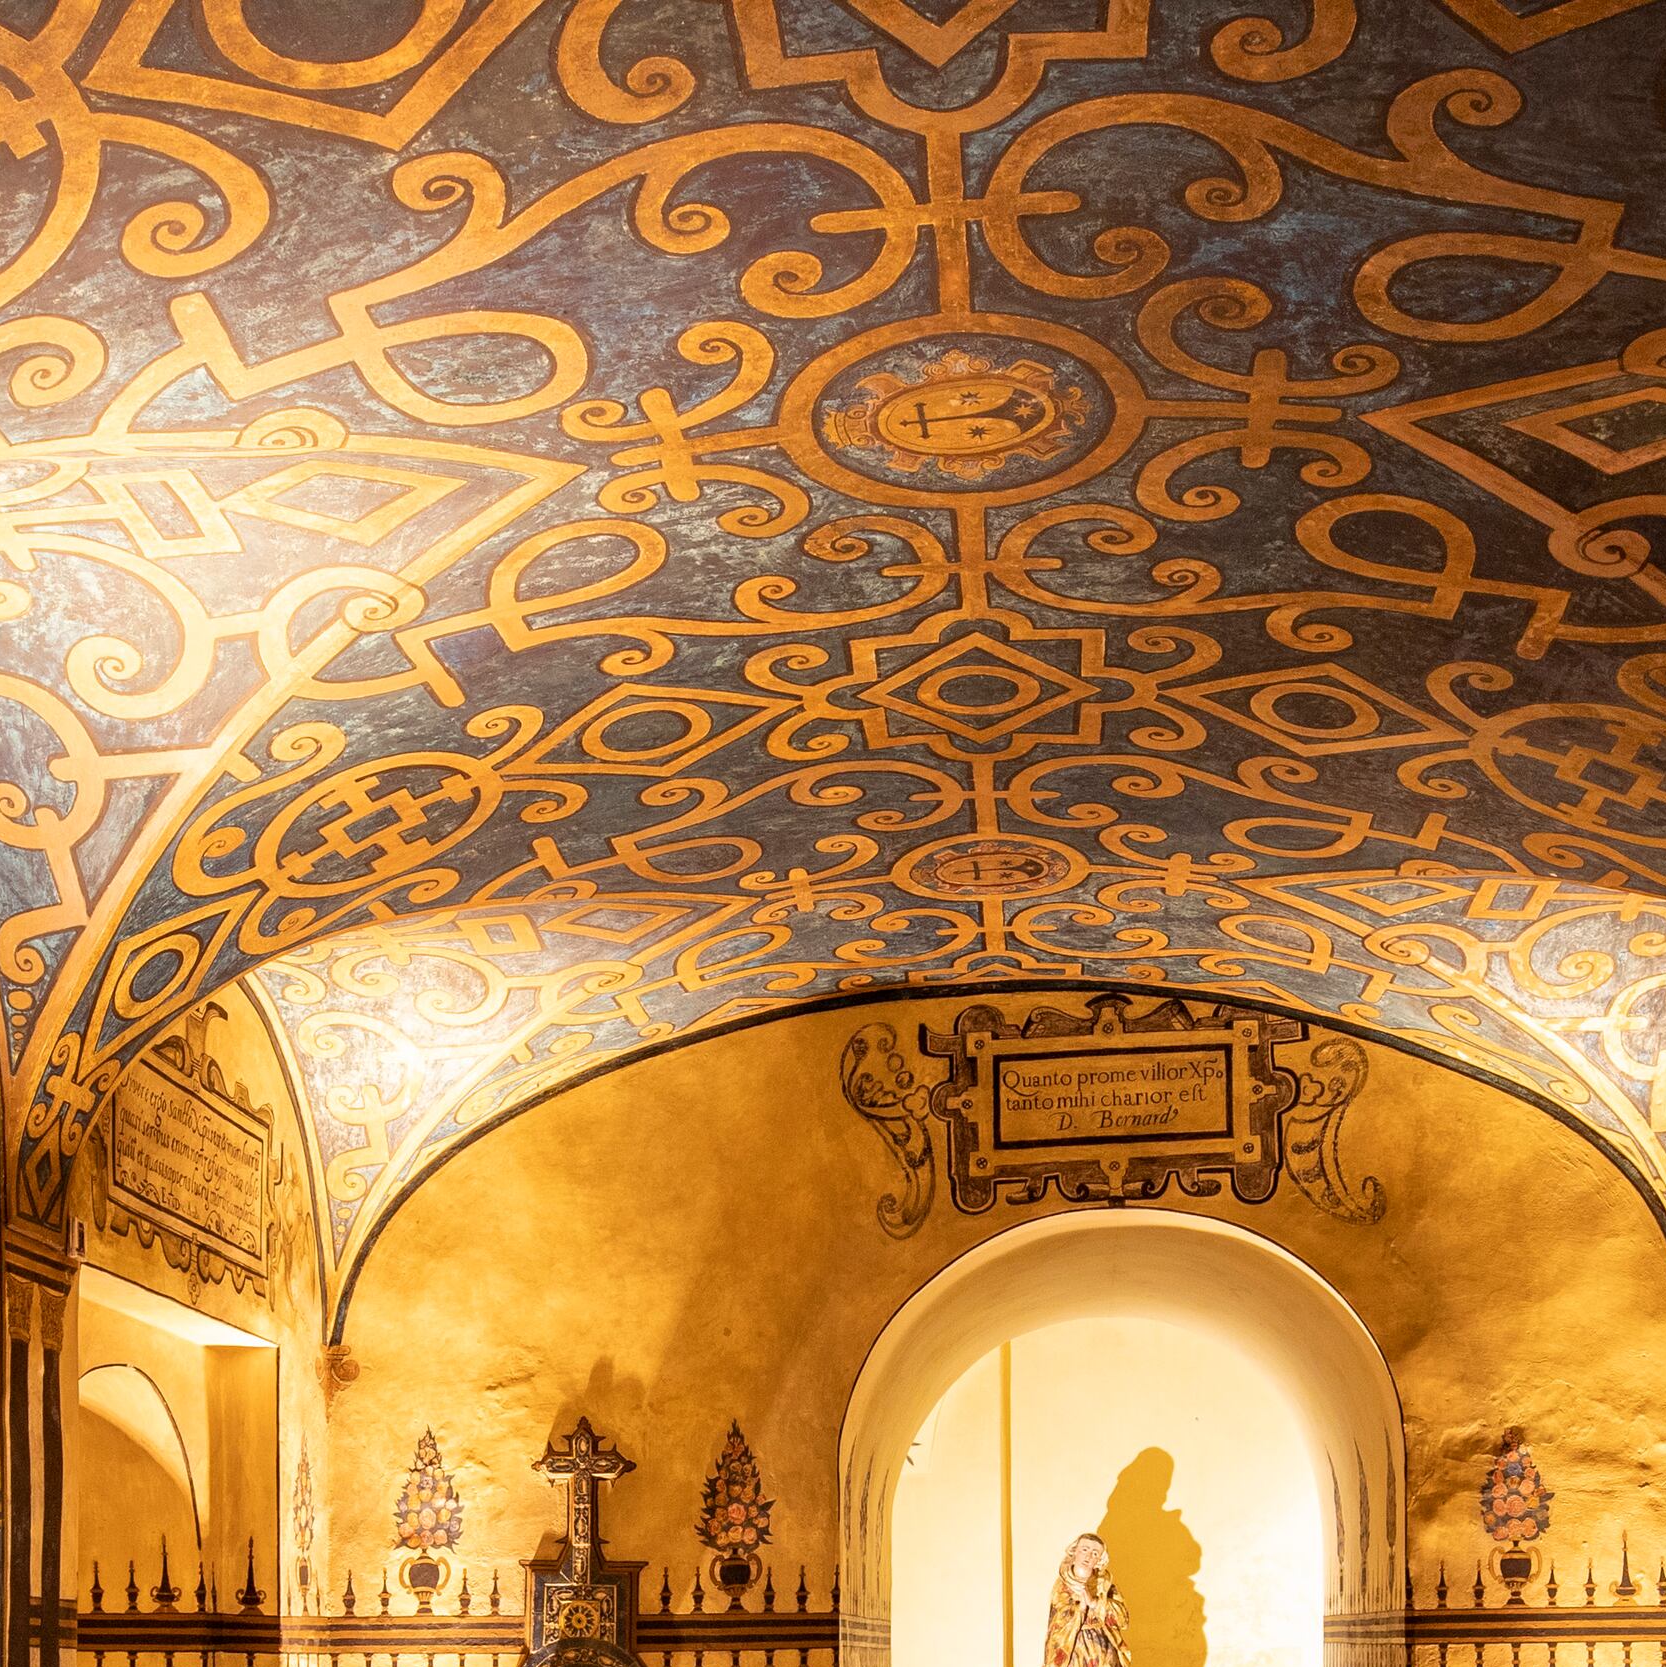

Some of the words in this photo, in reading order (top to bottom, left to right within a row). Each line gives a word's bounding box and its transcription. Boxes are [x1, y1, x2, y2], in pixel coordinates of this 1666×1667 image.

[1002, 1069, 1072, 1097] Quanto
[1140, 1062, 1187, 1082] vilior
[1005, 1092, 1054, 1112] tanto
[1057, 1091, 1096, 1109] mihi
[1100, 1089, 1173, 1107] charior
